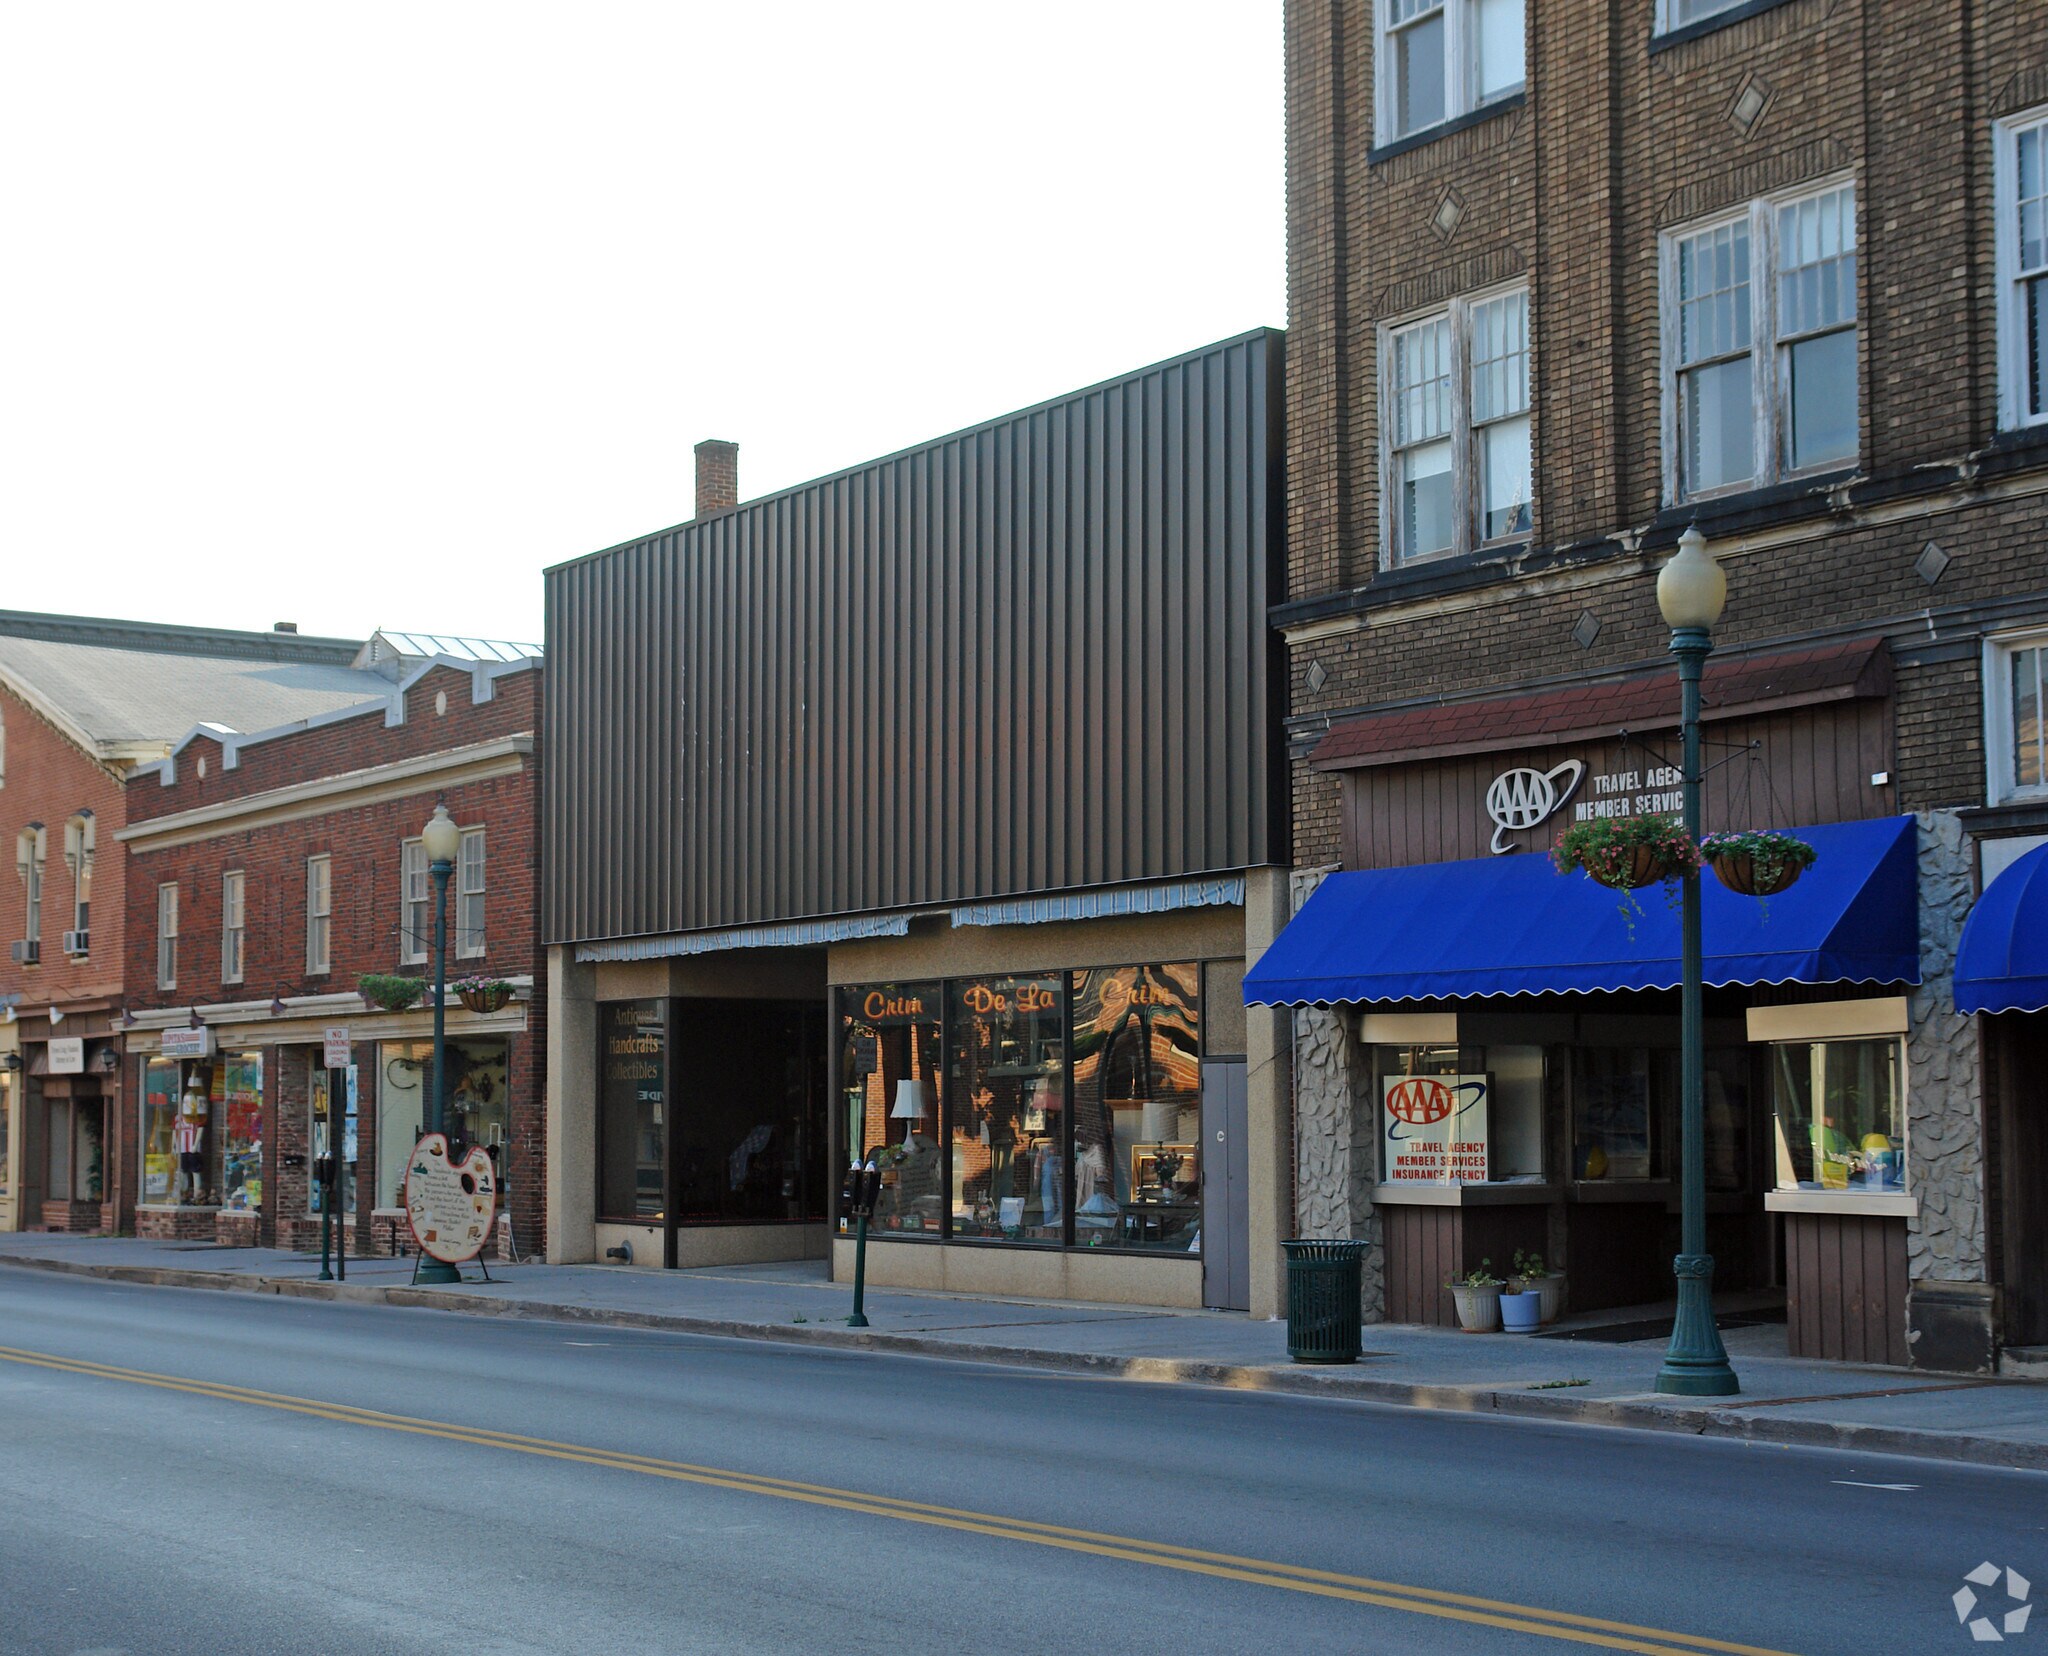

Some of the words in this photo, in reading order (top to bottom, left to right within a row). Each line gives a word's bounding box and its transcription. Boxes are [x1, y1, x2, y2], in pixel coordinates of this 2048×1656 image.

[1594, 771, 1642, 794] TRAVEL
[1646, 765, 1683, 788] AGEN
[1494, 770, 1546, 826] AAA
[1576, 797, 1630, 822] MEMBER
[1636, 790, 1684, 815] SERVIC
[863, 991, 924, 1019] Crim
[963, 984, 1006, 1013] De
[1017, 982, 1056, 1011] La
[1099, 978, 1171, 1006] Crim
[615, 1007, 654, 1025] Antiques
[332, 1030, 342, 1038] NO
[609, 1033, 659, 1055] Handcrafts
[606, 1062, 658, 1080] Collectibles
[1394, 1079, 1449, 1124] AAA
[1410, 1142, 1444, 1153] TRAVEL
[1448, 1142, 1485, 1153] AGENCY
[1396, 1156, 1436, 1166] MEMBER
[1440, 1156, 1486, 1166] SERVICES
[1392, 1169, 1445, 1180] INSURANCE
[1449, 1169, 1486, 1180] AGENCY
